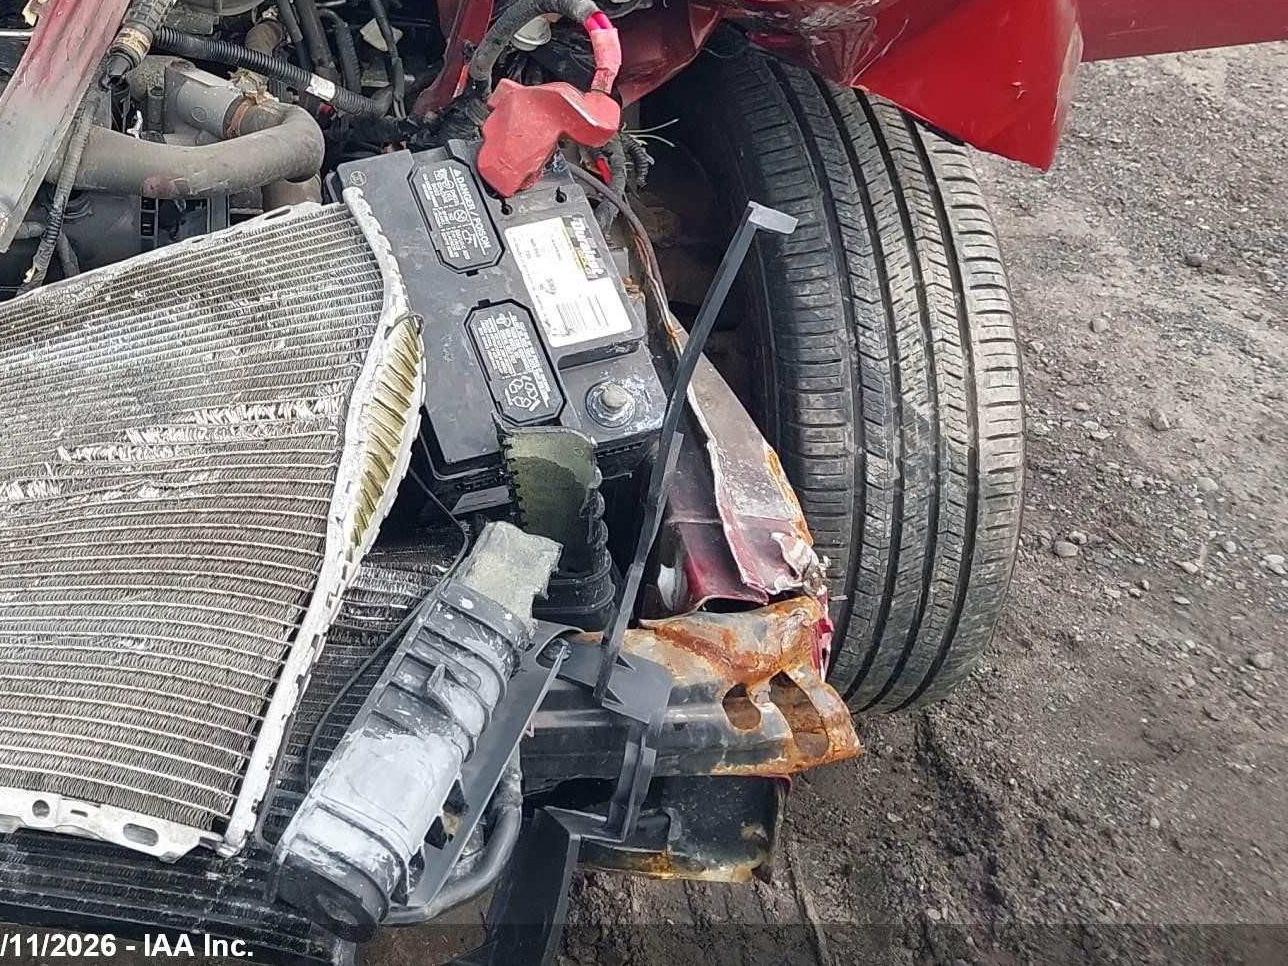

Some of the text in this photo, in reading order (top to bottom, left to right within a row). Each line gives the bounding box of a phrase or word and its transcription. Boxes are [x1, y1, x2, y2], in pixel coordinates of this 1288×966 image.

[455, 176, 476, 211] DANGER
[473, 217, 492, 249] POISON
[570, 217, 605, 276] Duralast
